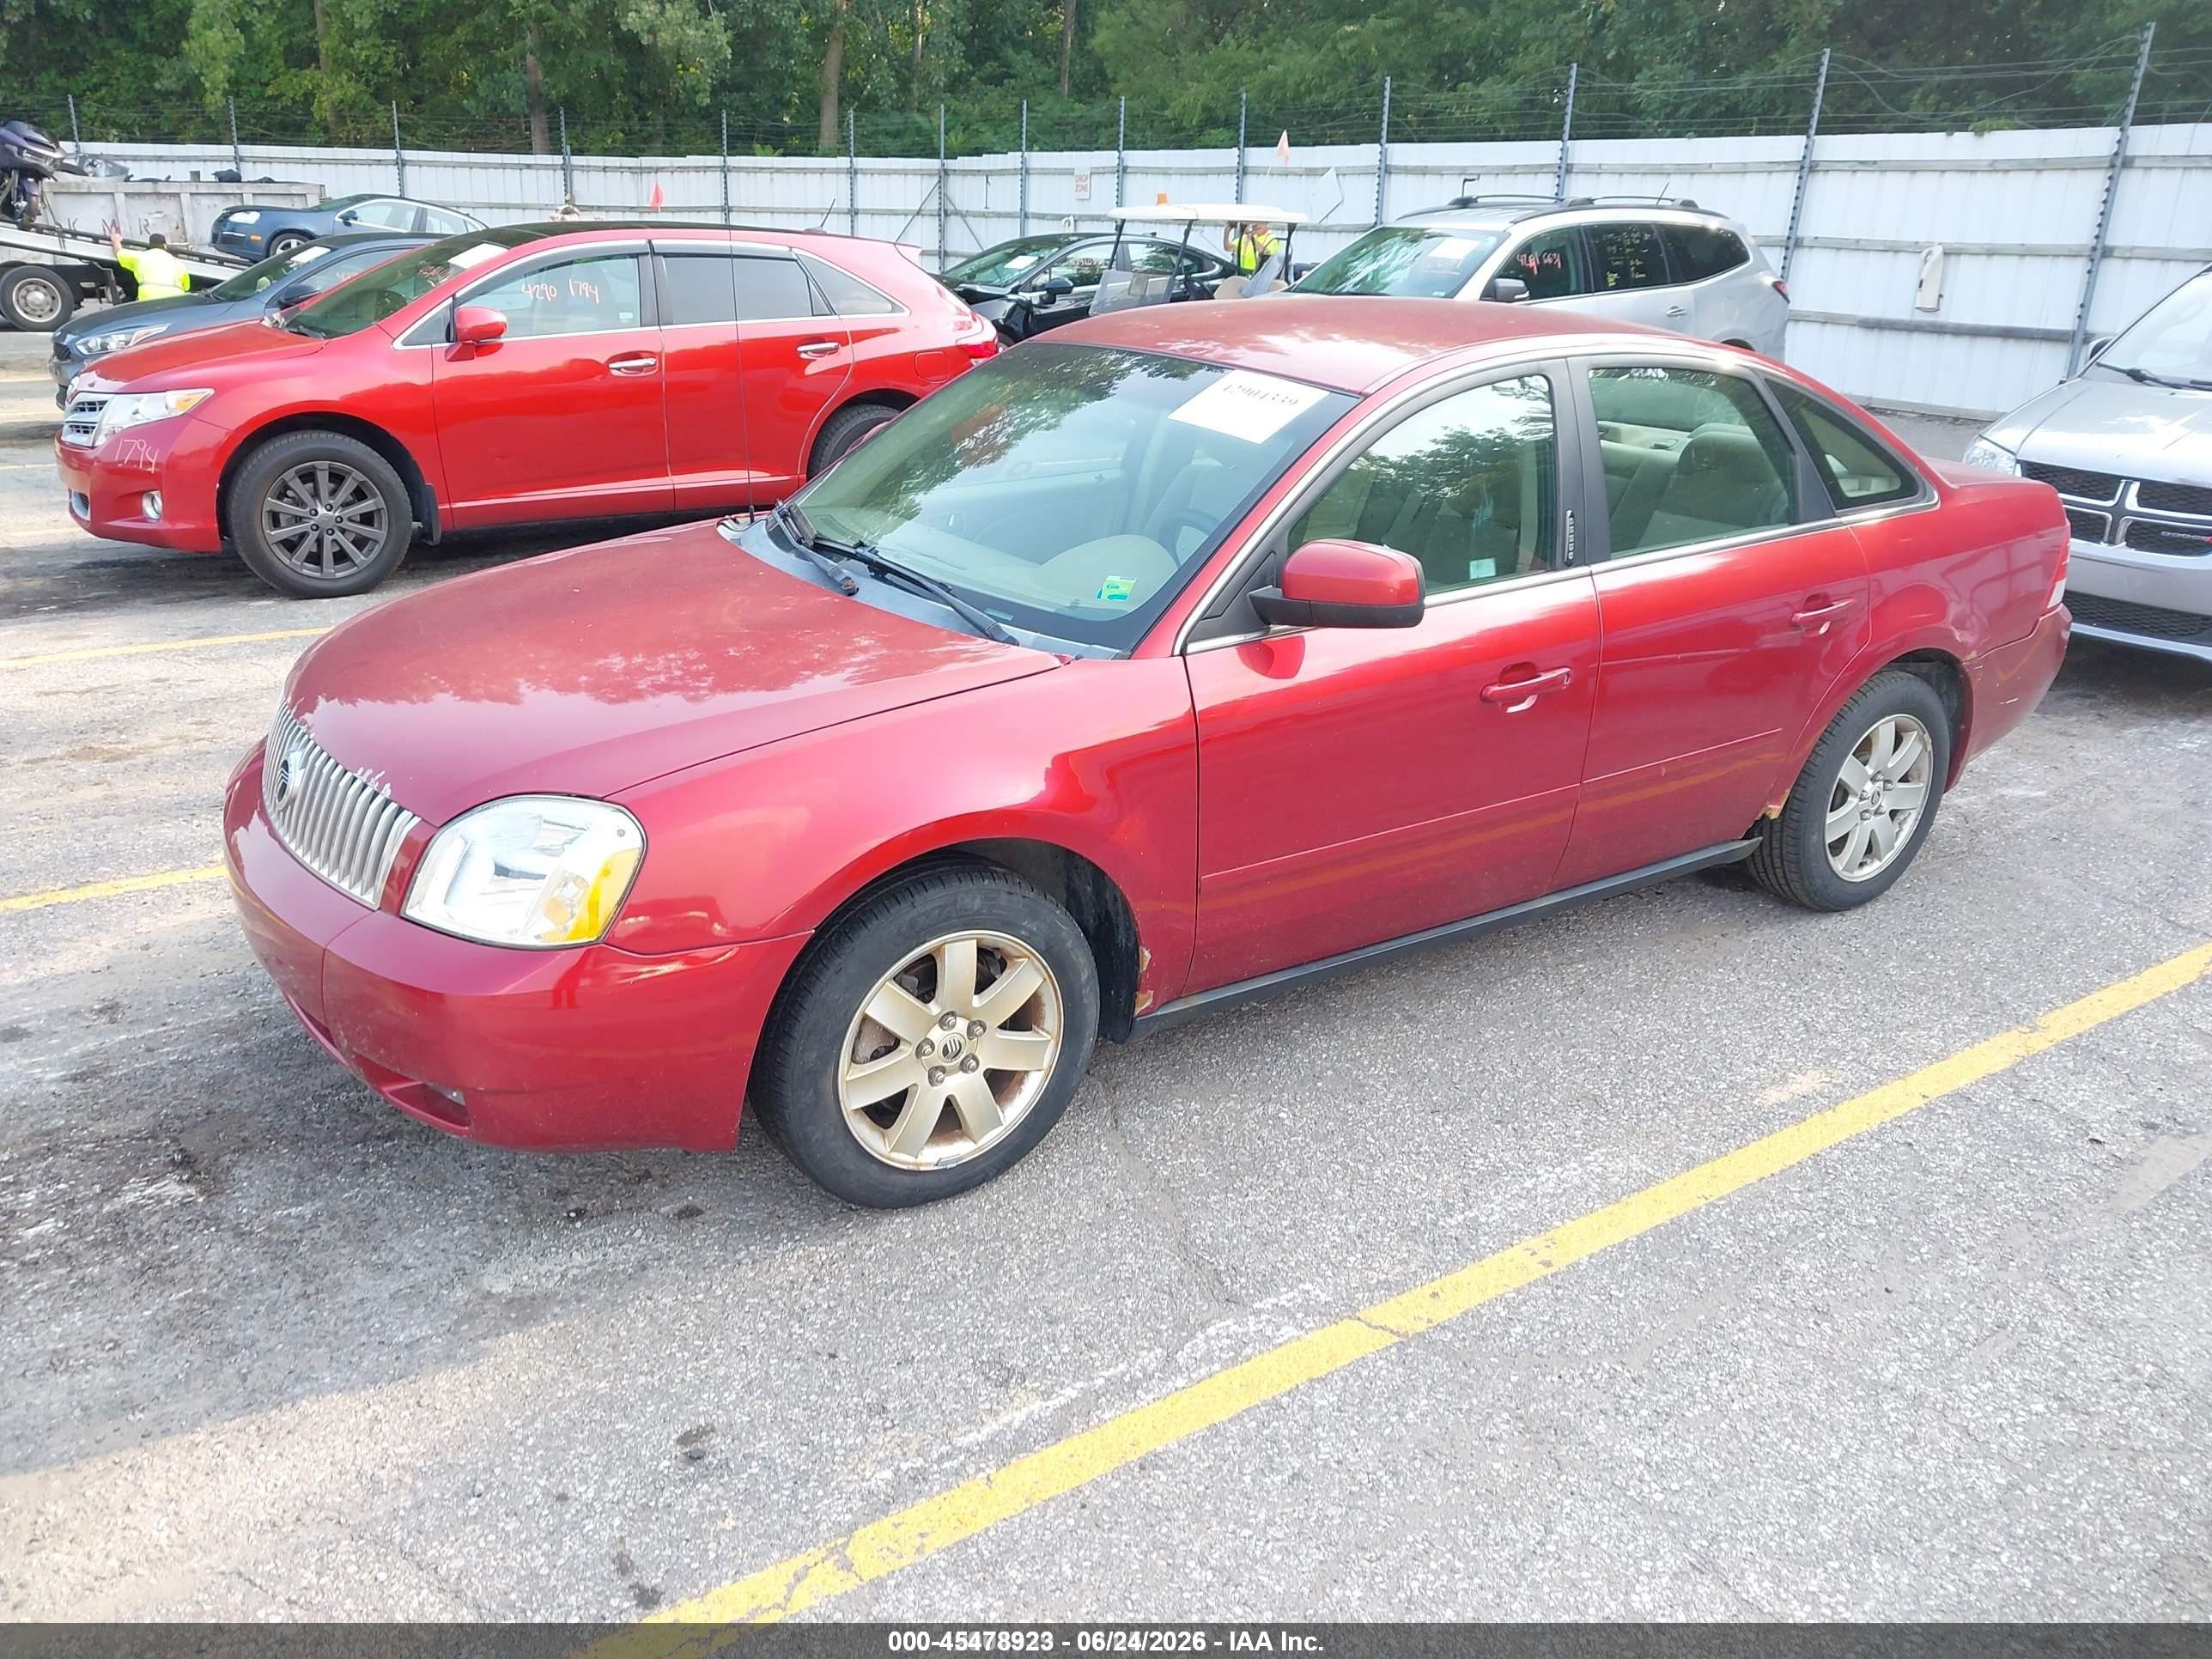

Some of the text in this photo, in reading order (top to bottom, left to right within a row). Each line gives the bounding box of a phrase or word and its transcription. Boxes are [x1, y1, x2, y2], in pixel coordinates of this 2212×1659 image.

[522, 278, 599, 304] 4290 1794
[115, 437, 159, 474] 1794
